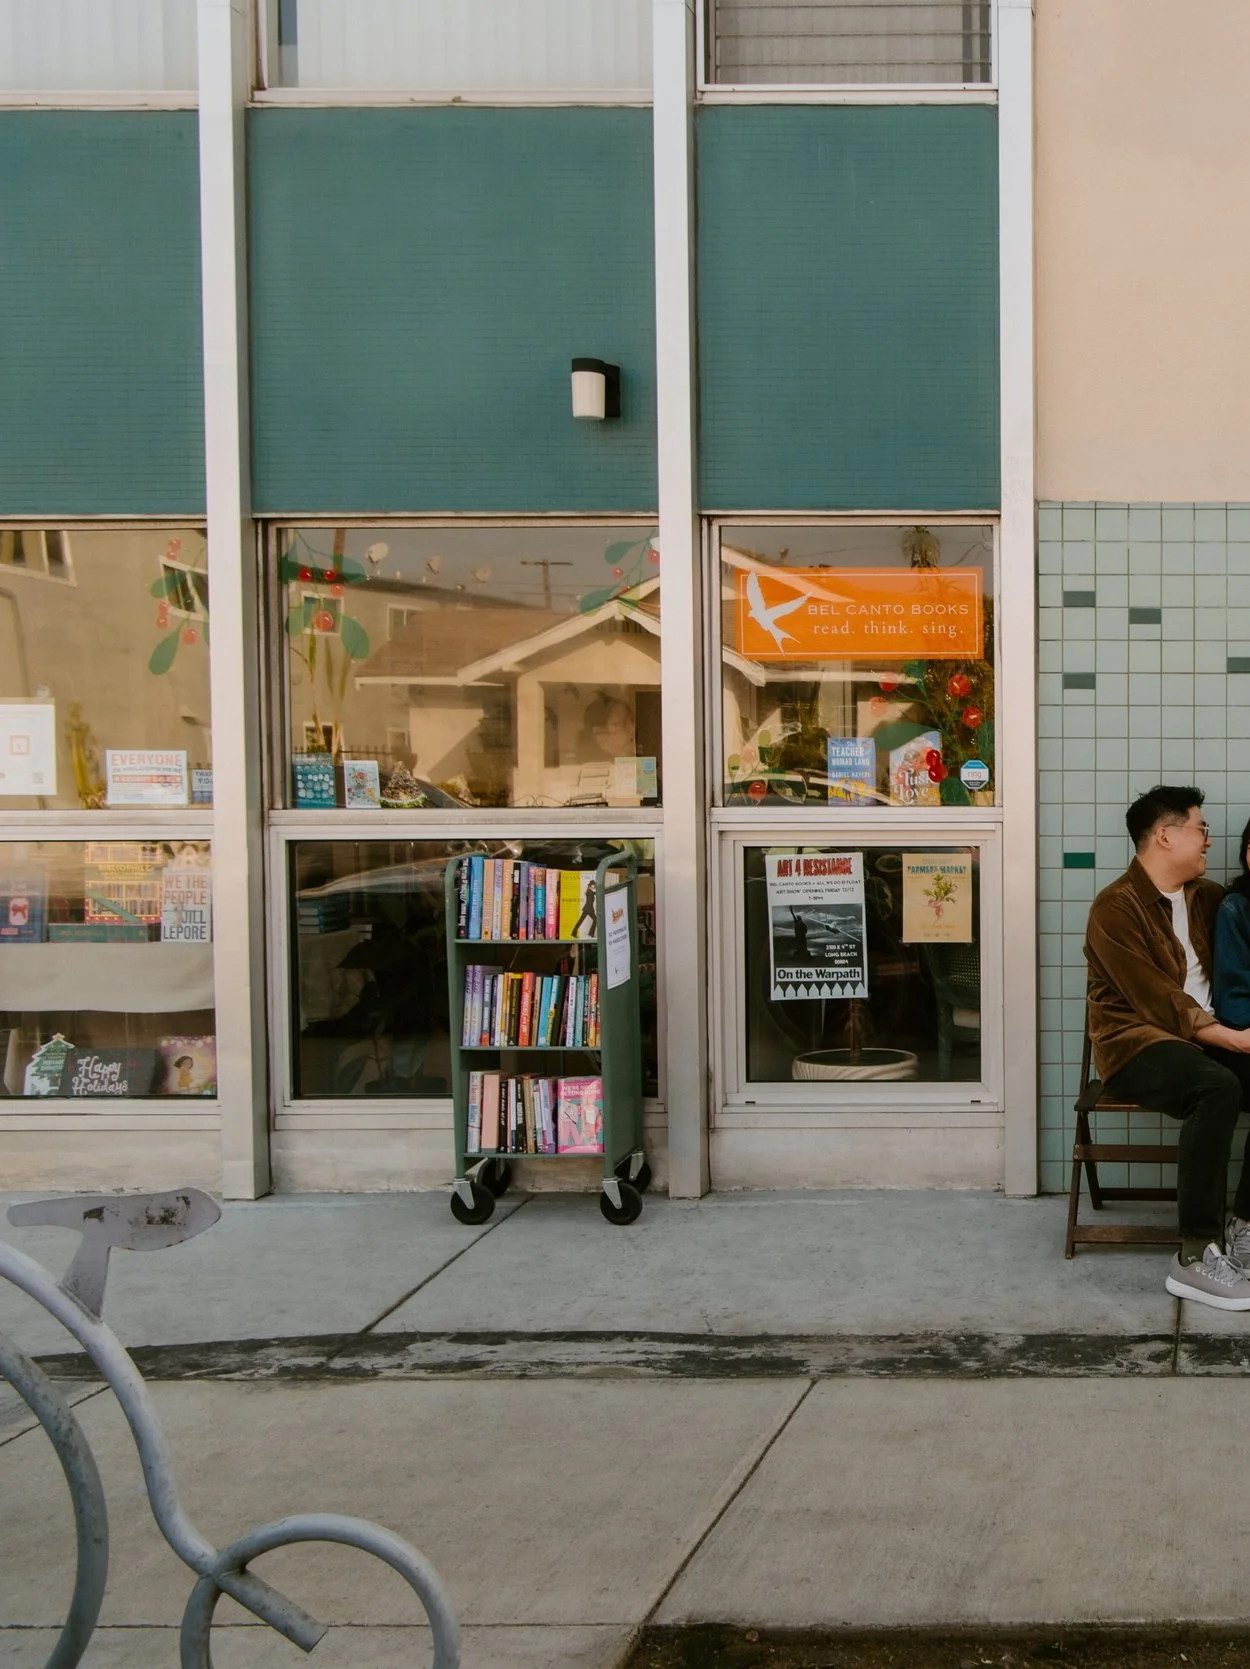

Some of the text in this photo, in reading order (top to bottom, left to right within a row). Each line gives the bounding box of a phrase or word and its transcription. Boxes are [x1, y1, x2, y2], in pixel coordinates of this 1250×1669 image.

[808, 604, 969, 616] BEL CANTO BOOKS
[813, 620, 964, 638] read. think. sing.
[831, 746, 864, 757] TEACHER
[111, 754, 182, 767] EVERYONE
[967, 771, 981, 779] ring
[894, 785, 929, 801] Love
[777, 858, 853, 877] ART 4 RESISTANCE
[164, 875, 182, 888] WE
[186, 874, 207, 888] THE
[163, 890, 207, 905] PEOPLE
[182, 909, 206, 924] JILL
[163, 926, 207, 940] LEPORE
[777, 968, 860, 980] On the Warpath
[76, 1056, 122, 1082] Happy
[71, 1077, 128, 1095] Holidays
